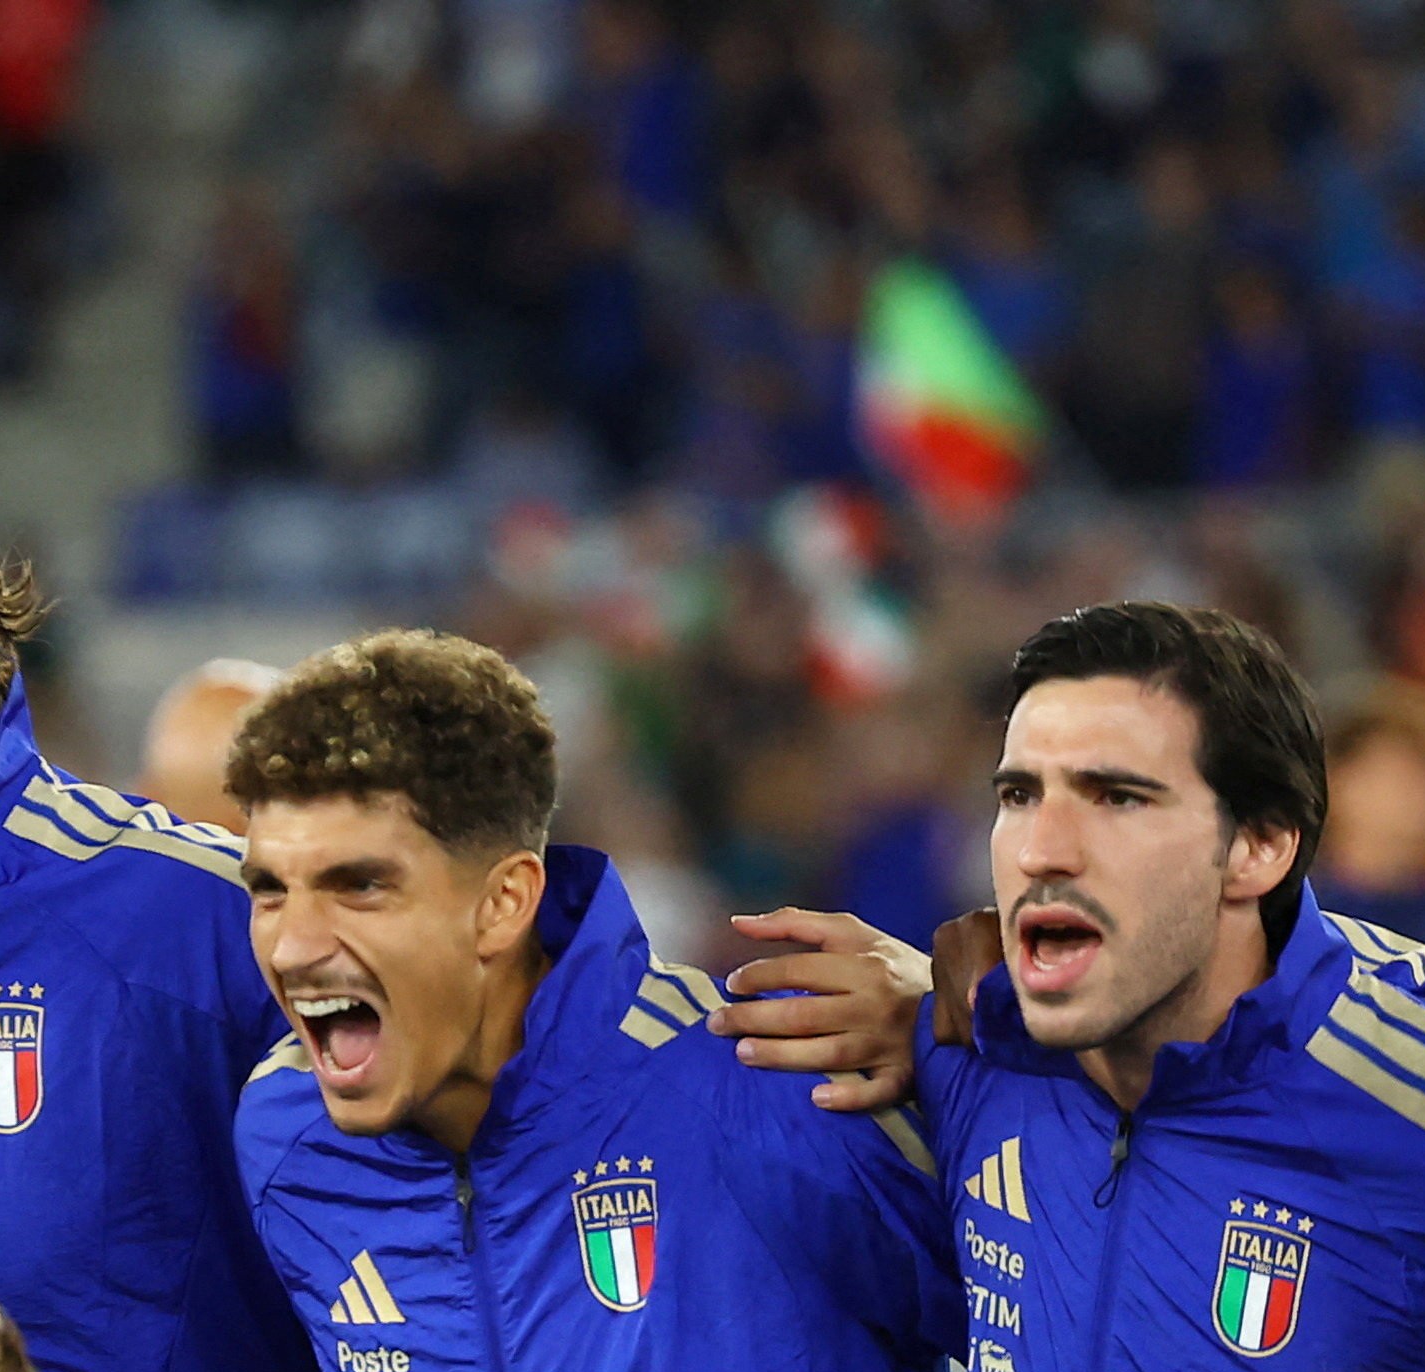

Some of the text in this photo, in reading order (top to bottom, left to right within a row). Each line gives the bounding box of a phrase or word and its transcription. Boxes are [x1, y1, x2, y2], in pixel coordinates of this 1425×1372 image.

[580, 1189, 652, 1221] ITALIA
[965, 1218, 1024, 1279] Poste
[1229, 1230, 1298, 1270] ITALIA
[973, 1285, 1021, 1336] TIM
